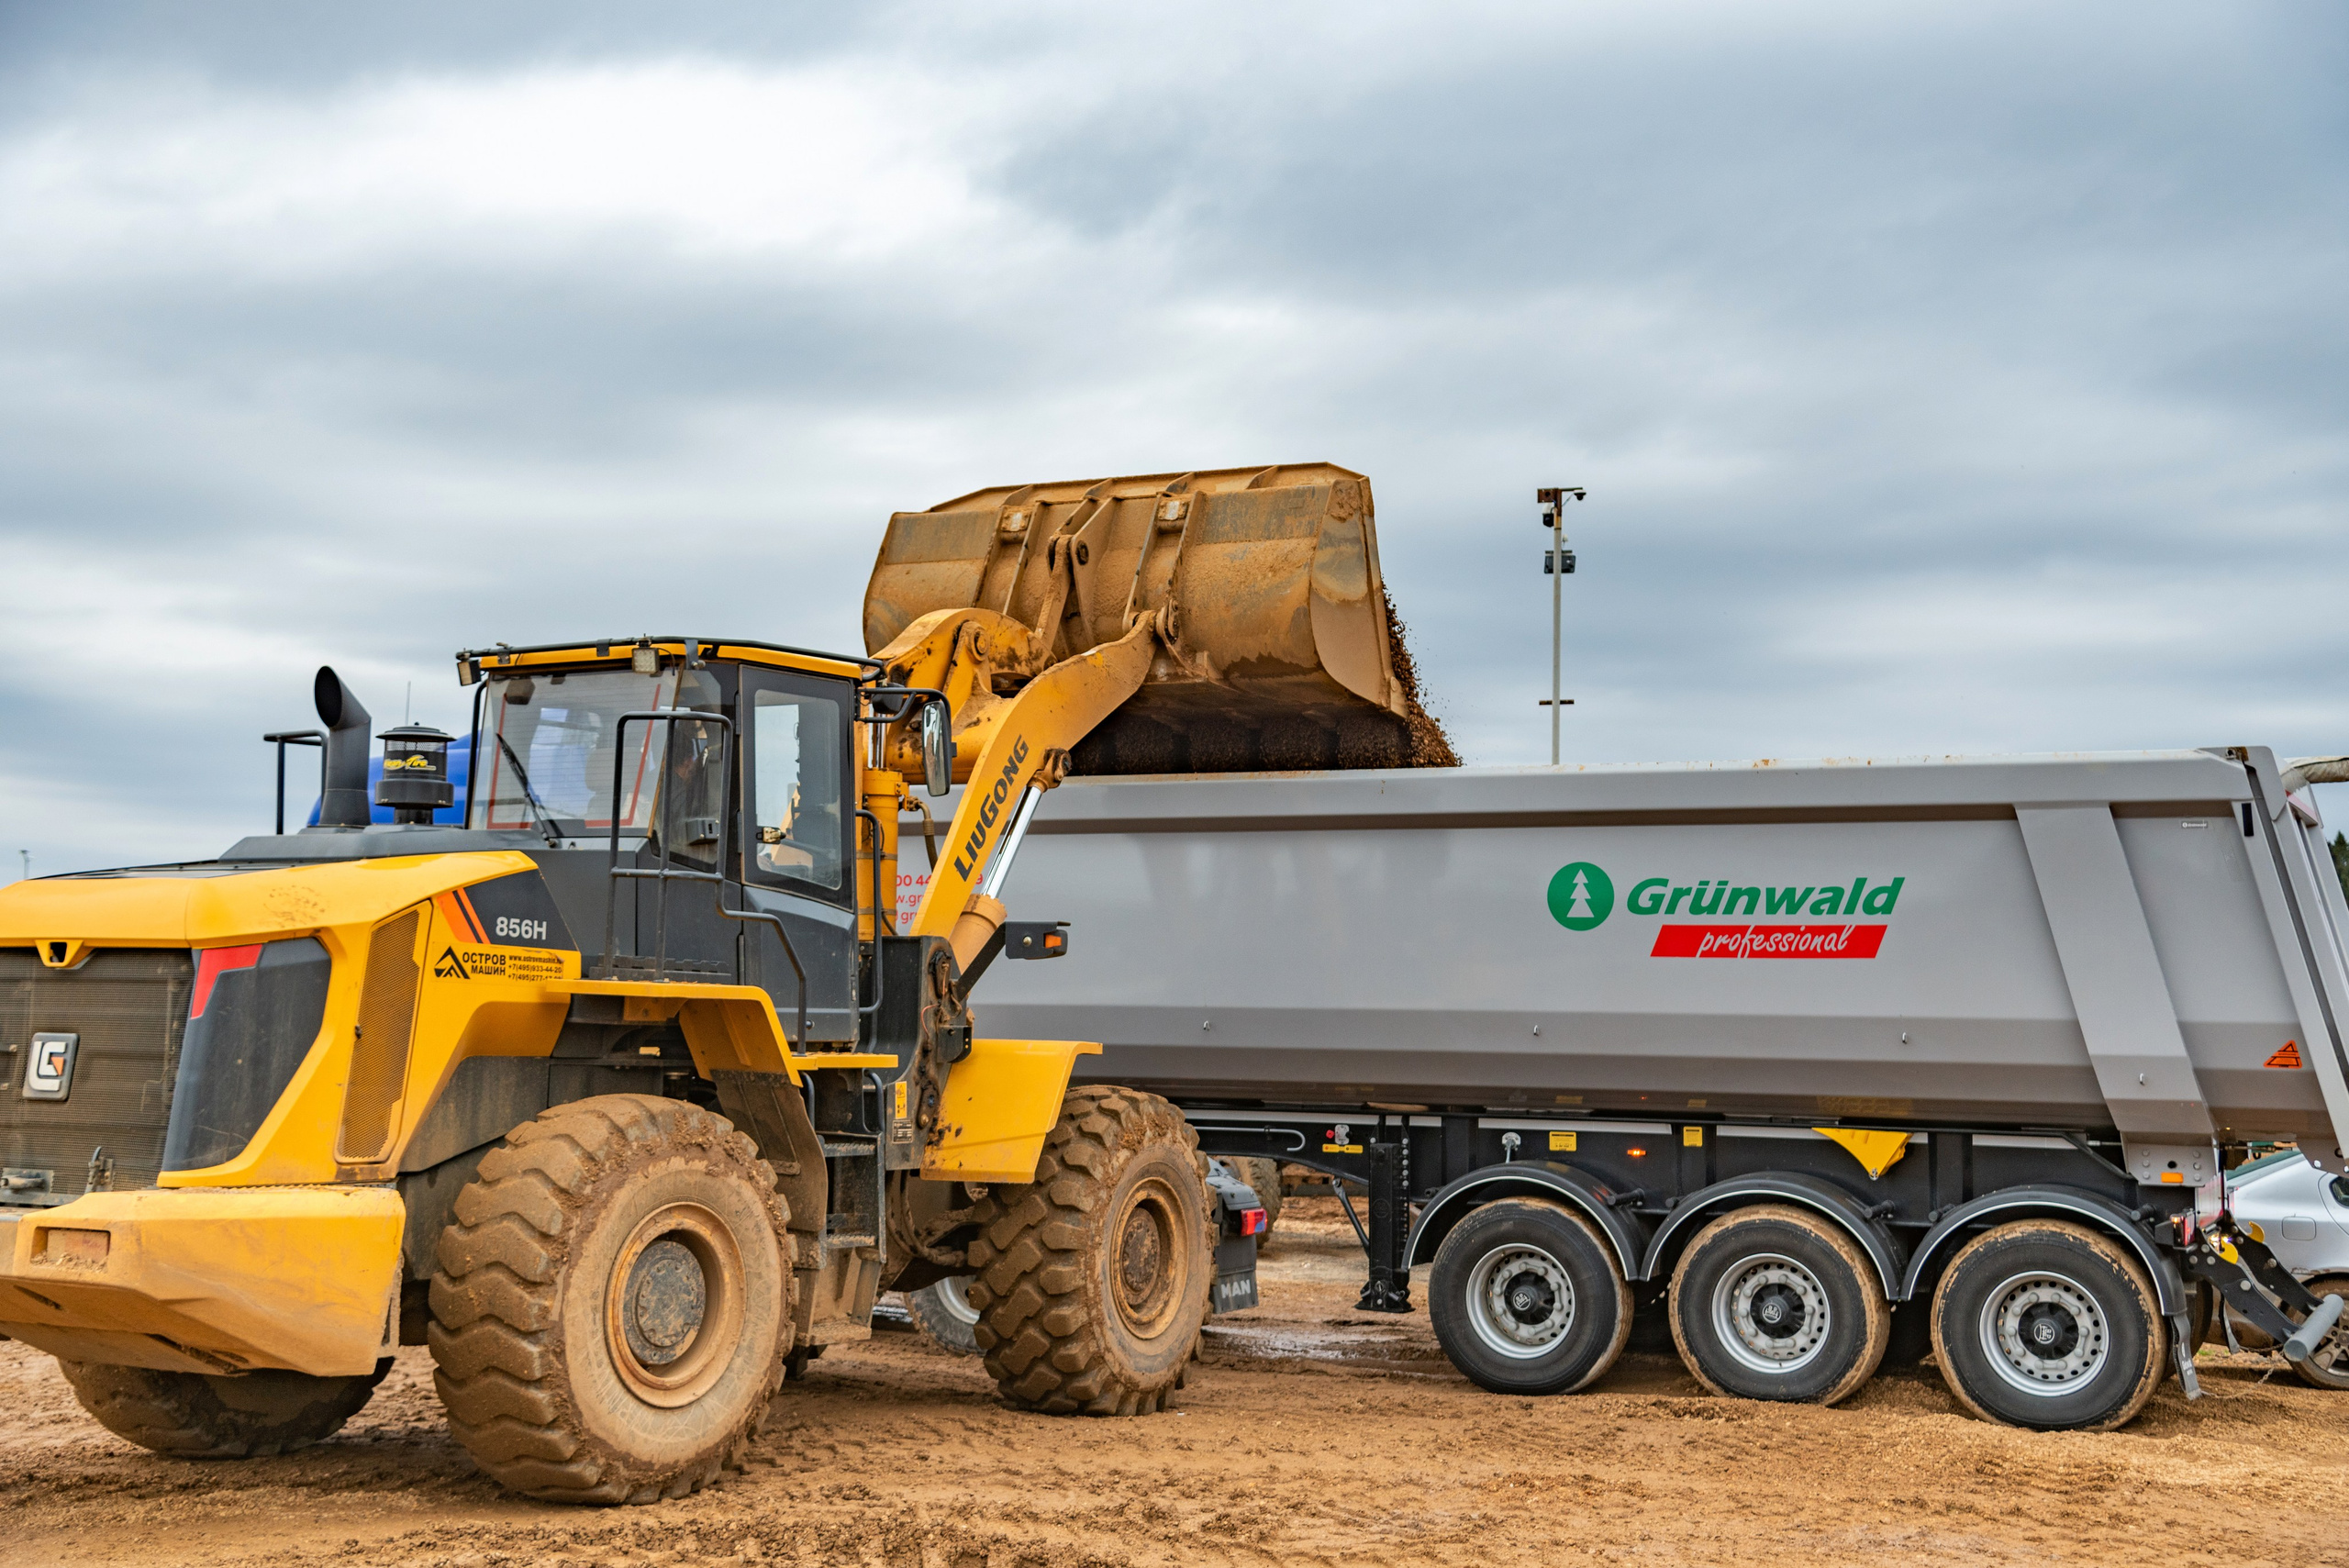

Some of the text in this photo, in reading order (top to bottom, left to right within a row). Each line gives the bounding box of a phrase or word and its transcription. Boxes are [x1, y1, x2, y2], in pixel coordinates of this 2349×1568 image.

[953, 734, 1030, 882] LIUGONG
[1626, 876, 1906, 916] Grünwald
[495, 917, 547, 940] 856H
[1696, 924, 1856, 959] professional
[462, 951, 507, 965] ОСТРОВ
[471, 964, 506, 976] МАШИН
[1220, 1279, 1251, 1298] MAN
